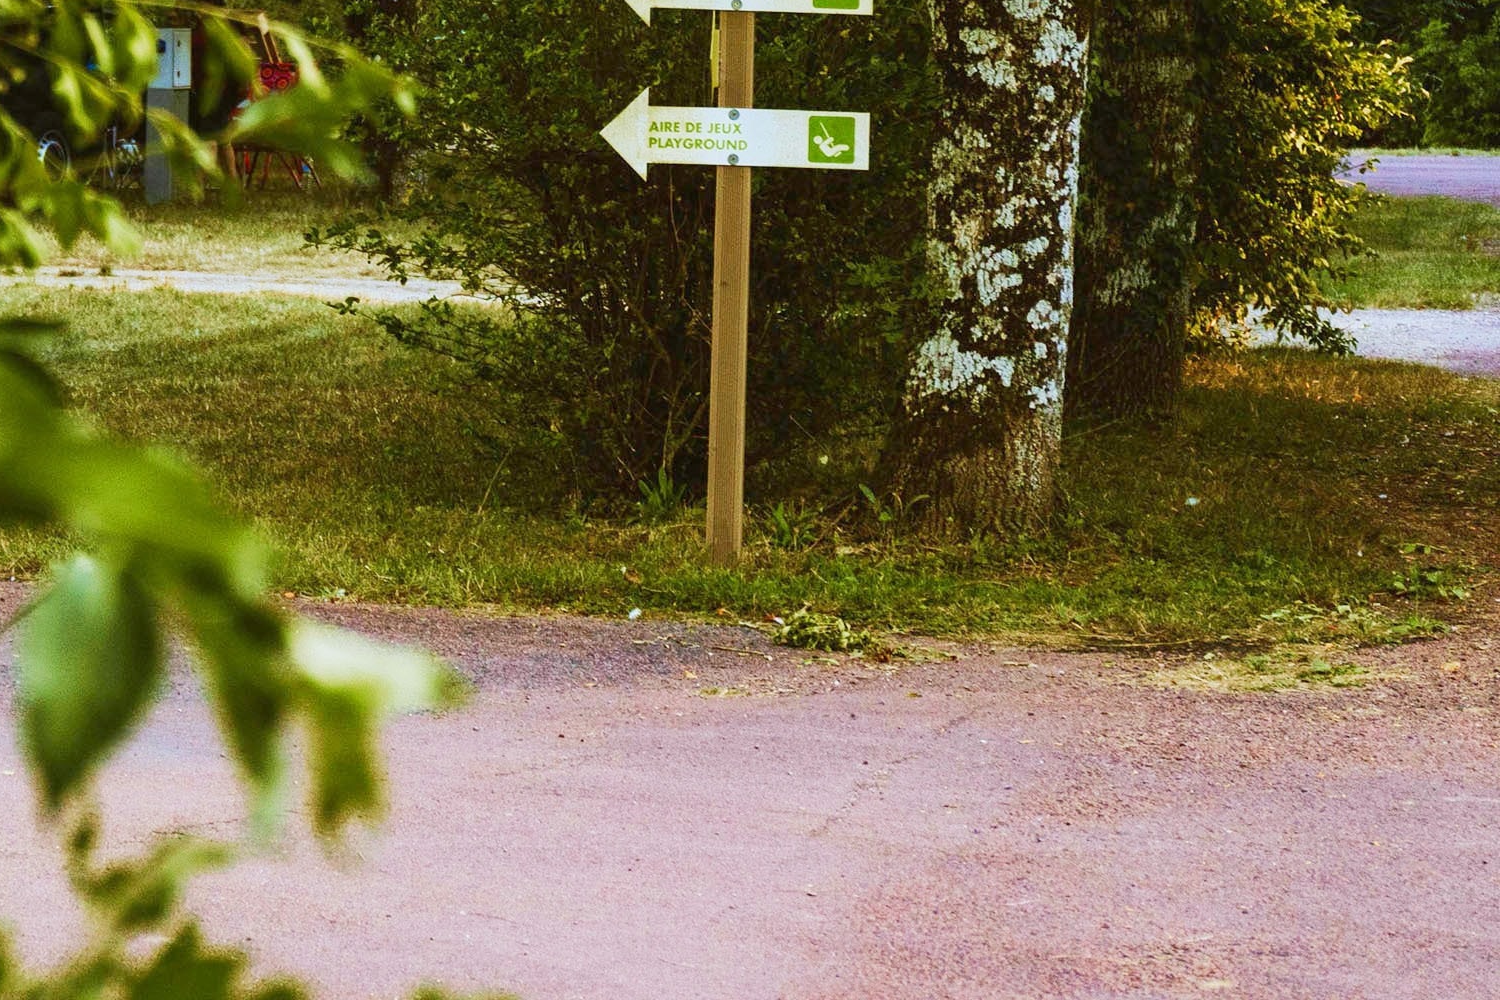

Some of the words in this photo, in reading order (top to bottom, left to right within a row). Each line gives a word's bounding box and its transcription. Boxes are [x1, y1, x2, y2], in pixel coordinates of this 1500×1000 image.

[648, 121, 680, 132] AIRE
[685, 122, 702, 133] DE
[708, 123, 741, 134] JEUX
[648, 137, 748, 150] PLAYGROUND
